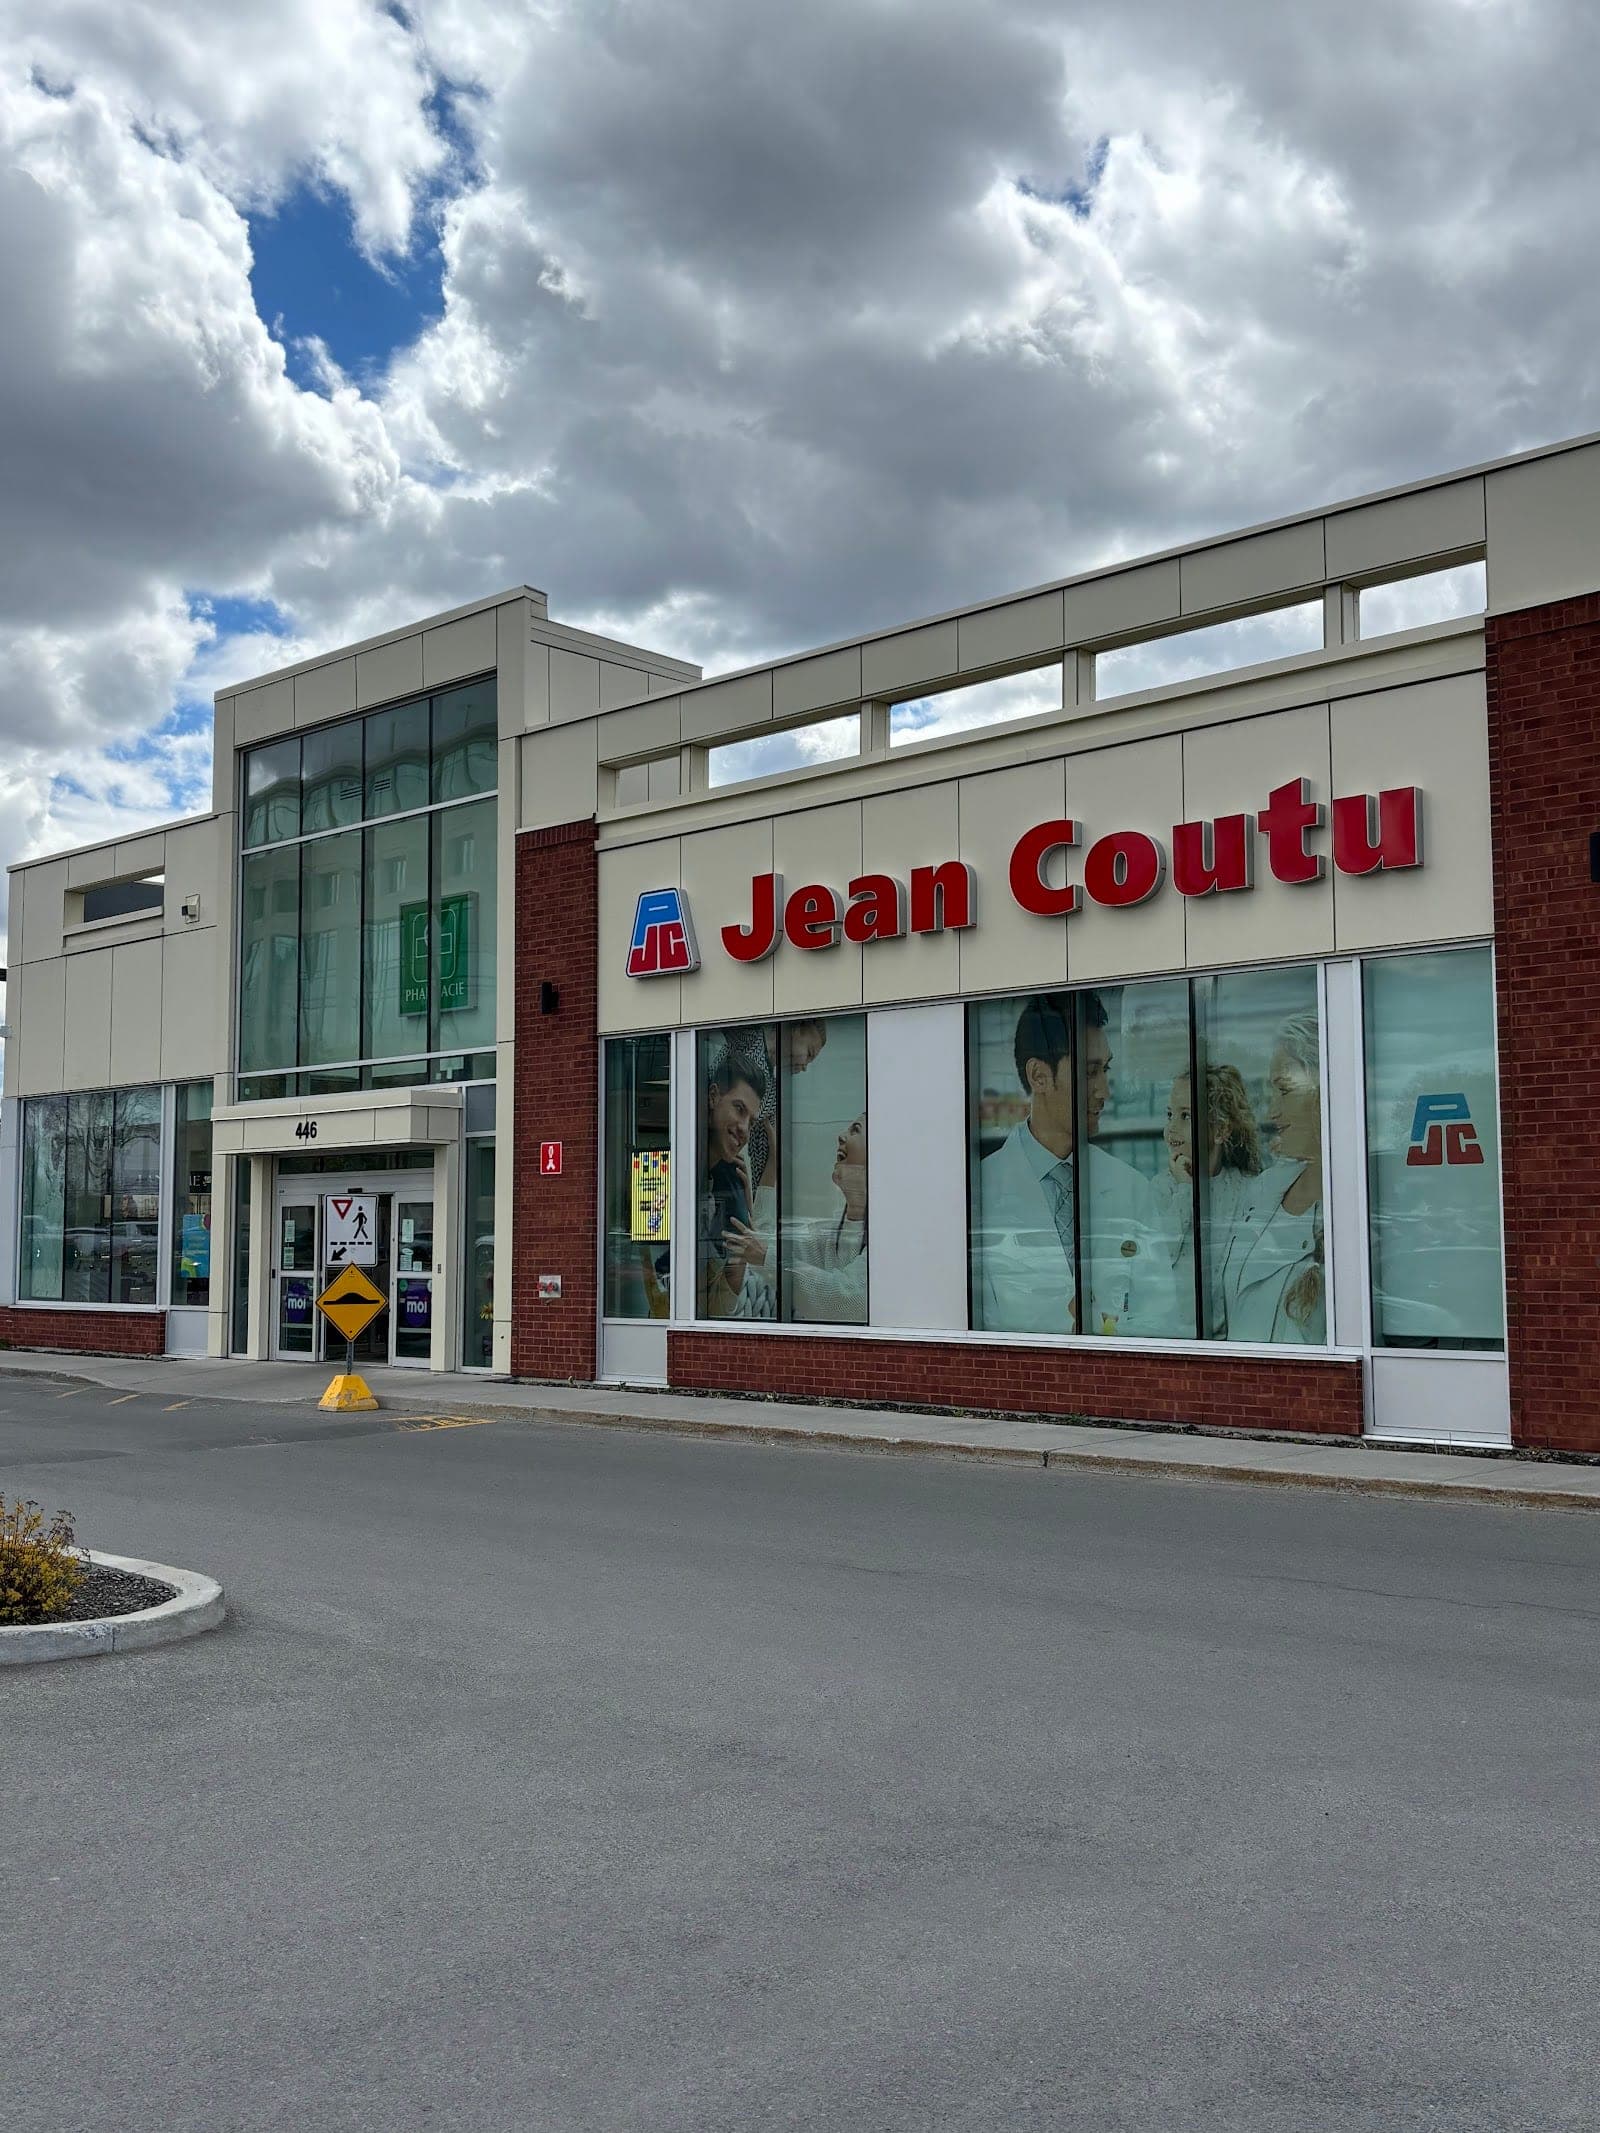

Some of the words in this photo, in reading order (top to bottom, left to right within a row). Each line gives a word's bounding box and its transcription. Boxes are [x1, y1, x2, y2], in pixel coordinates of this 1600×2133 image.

[721, 860, 976, 963] Jean
[1008, 777, 1424, 917] Coutu
[405, 981, 465, 1002] PHAACIE
[295, 1121, 317, 1139] 446
[287, 1297, 306, 1310] moi
[406, 1299, 428, 1314] moi
